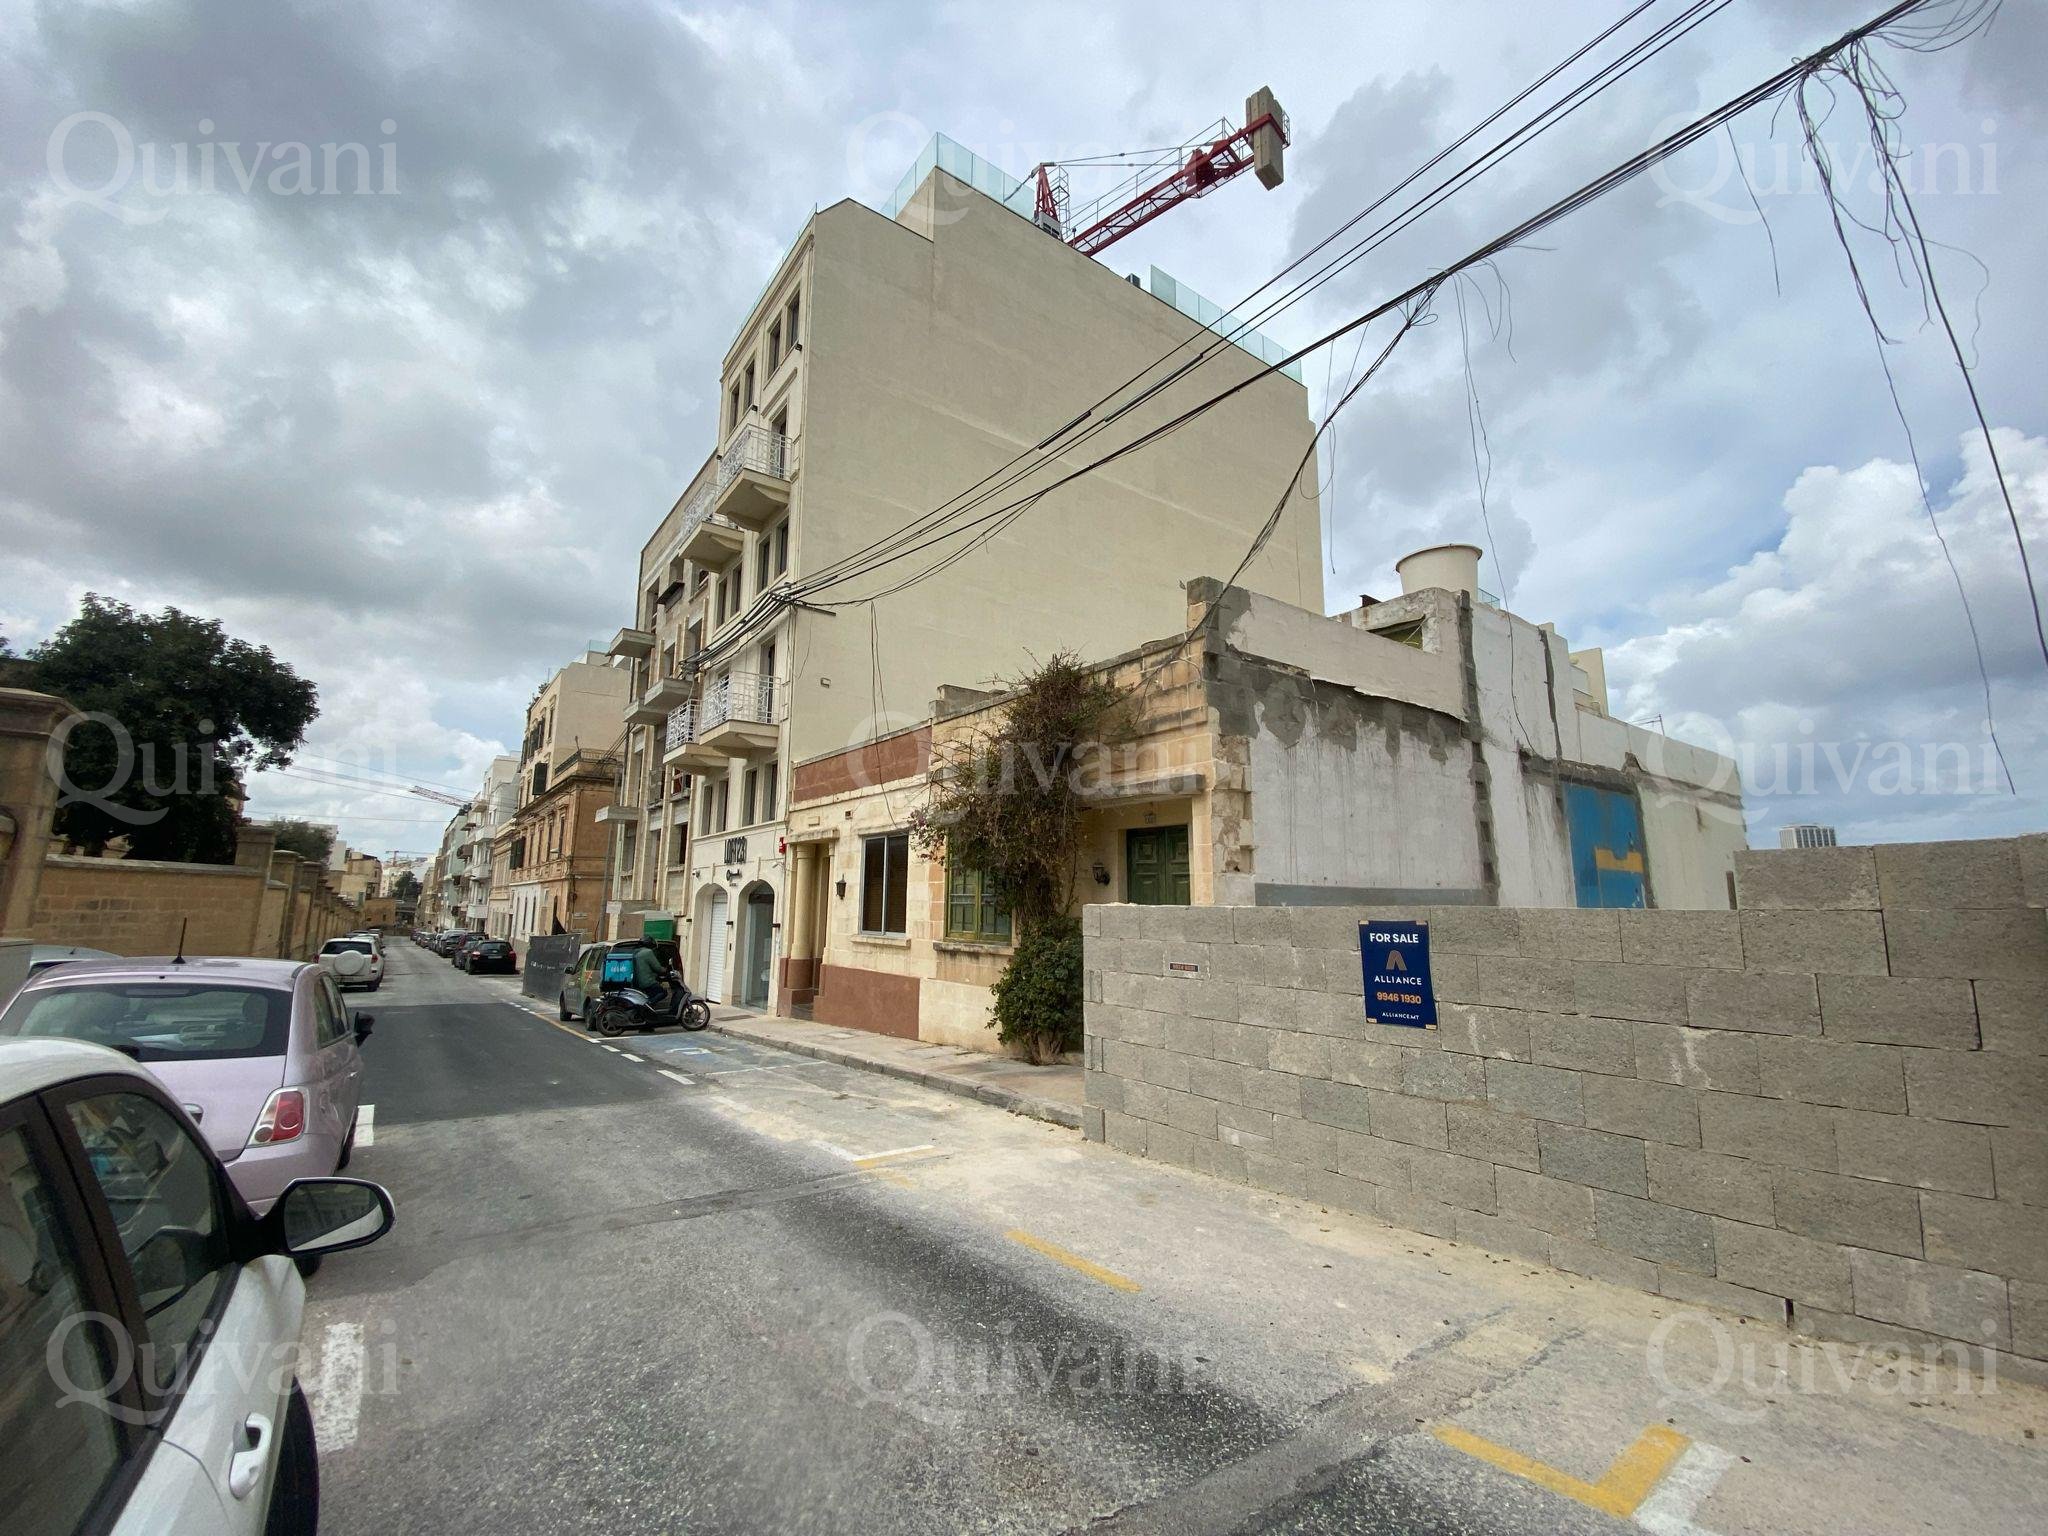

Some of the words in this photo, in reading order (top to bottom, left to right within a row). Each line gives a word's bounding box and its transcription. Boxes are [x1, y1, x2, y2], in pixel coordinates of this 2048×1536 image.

[1369, 932, 1391, 943] FOR
[1393, 933, 1419, 944] SALE
[1374, 975, 1422, 986] ALLIANCE
[1400, 994, 1422, 1004] 1930
